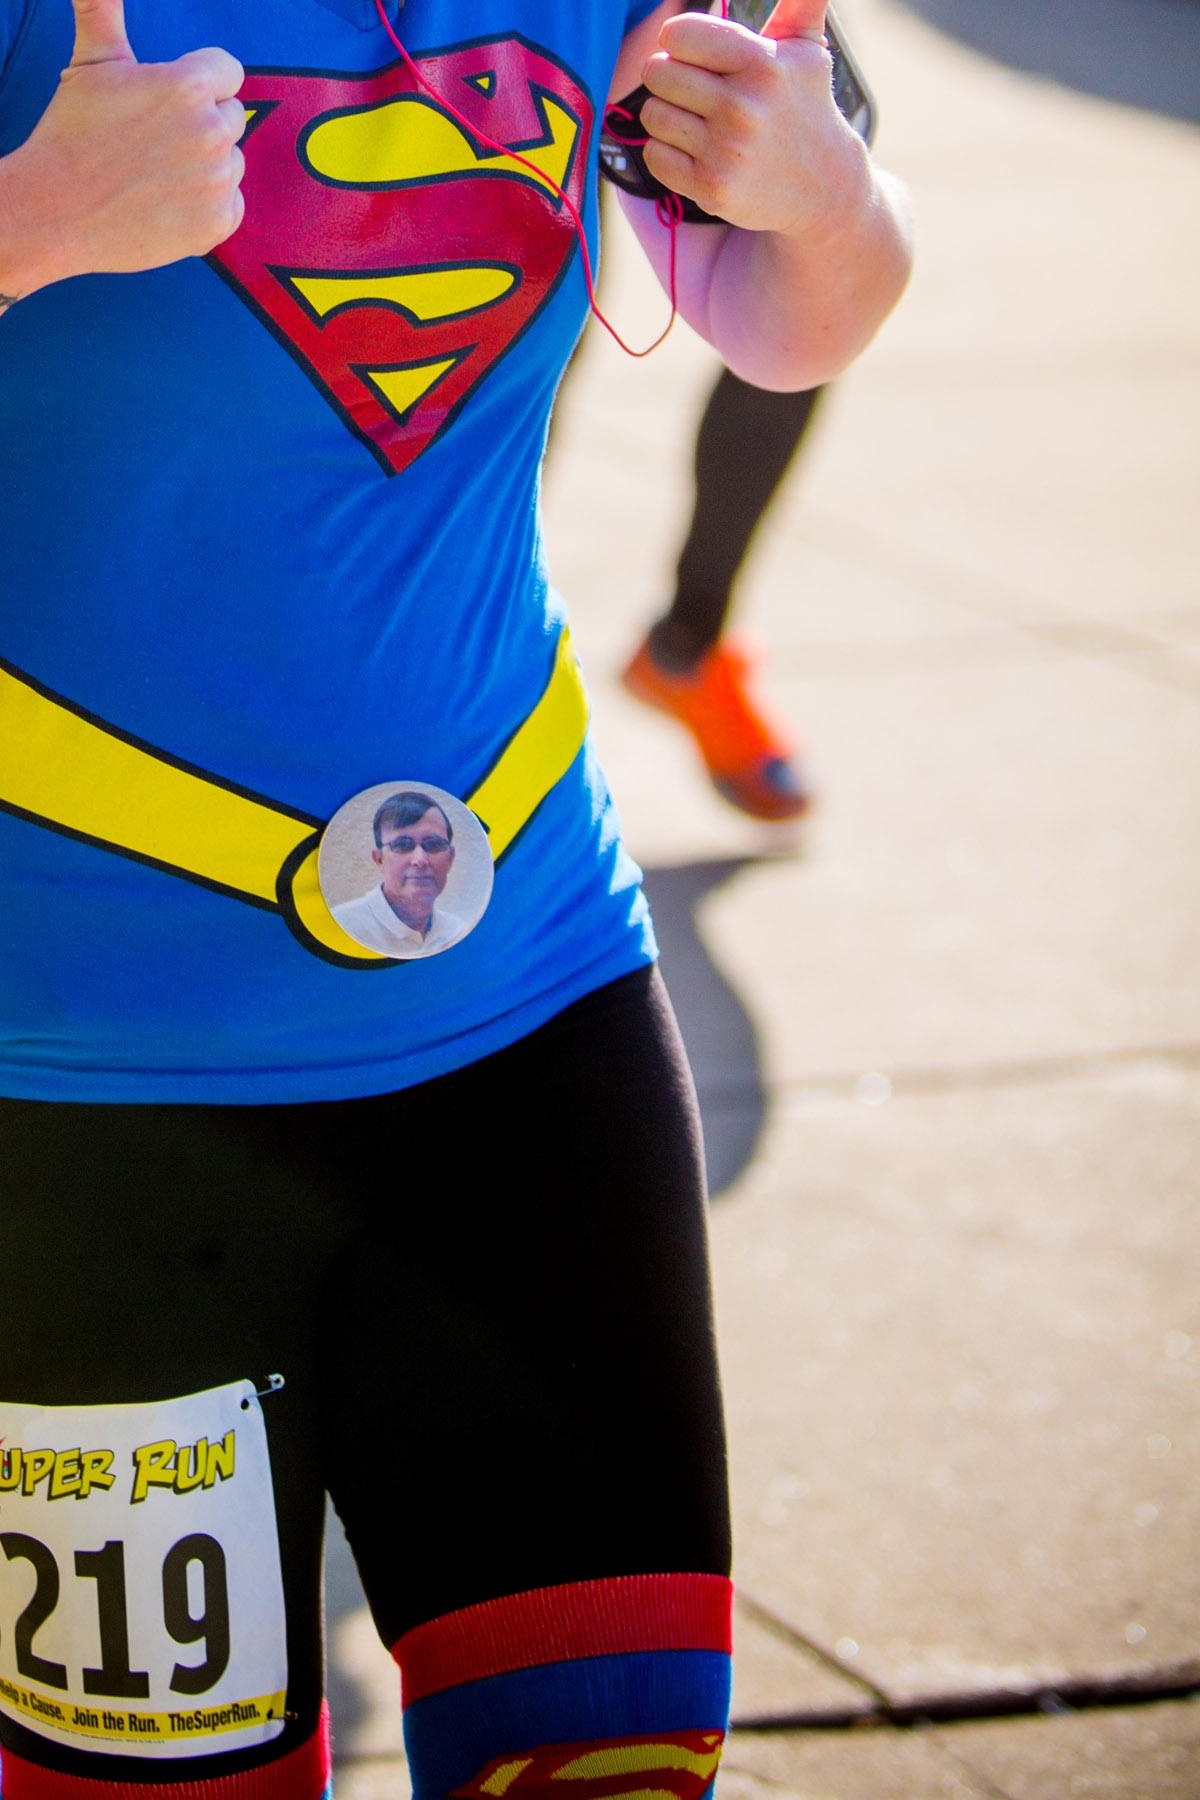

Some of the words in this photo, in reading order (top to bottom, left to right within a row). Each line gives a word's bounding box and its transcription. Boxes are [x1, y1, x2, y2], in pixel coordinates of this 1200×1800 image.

[129, 1429, 235, 1504] RUN
[30, 1692, 65, 1721] Cause.
[72, 1706, 99, 1728] Join
[102, 1711, 125, 1731] the
[128, 1713, 160, 1733] Run.
[168, 1702, 260, 1732] TheSuperRun.
